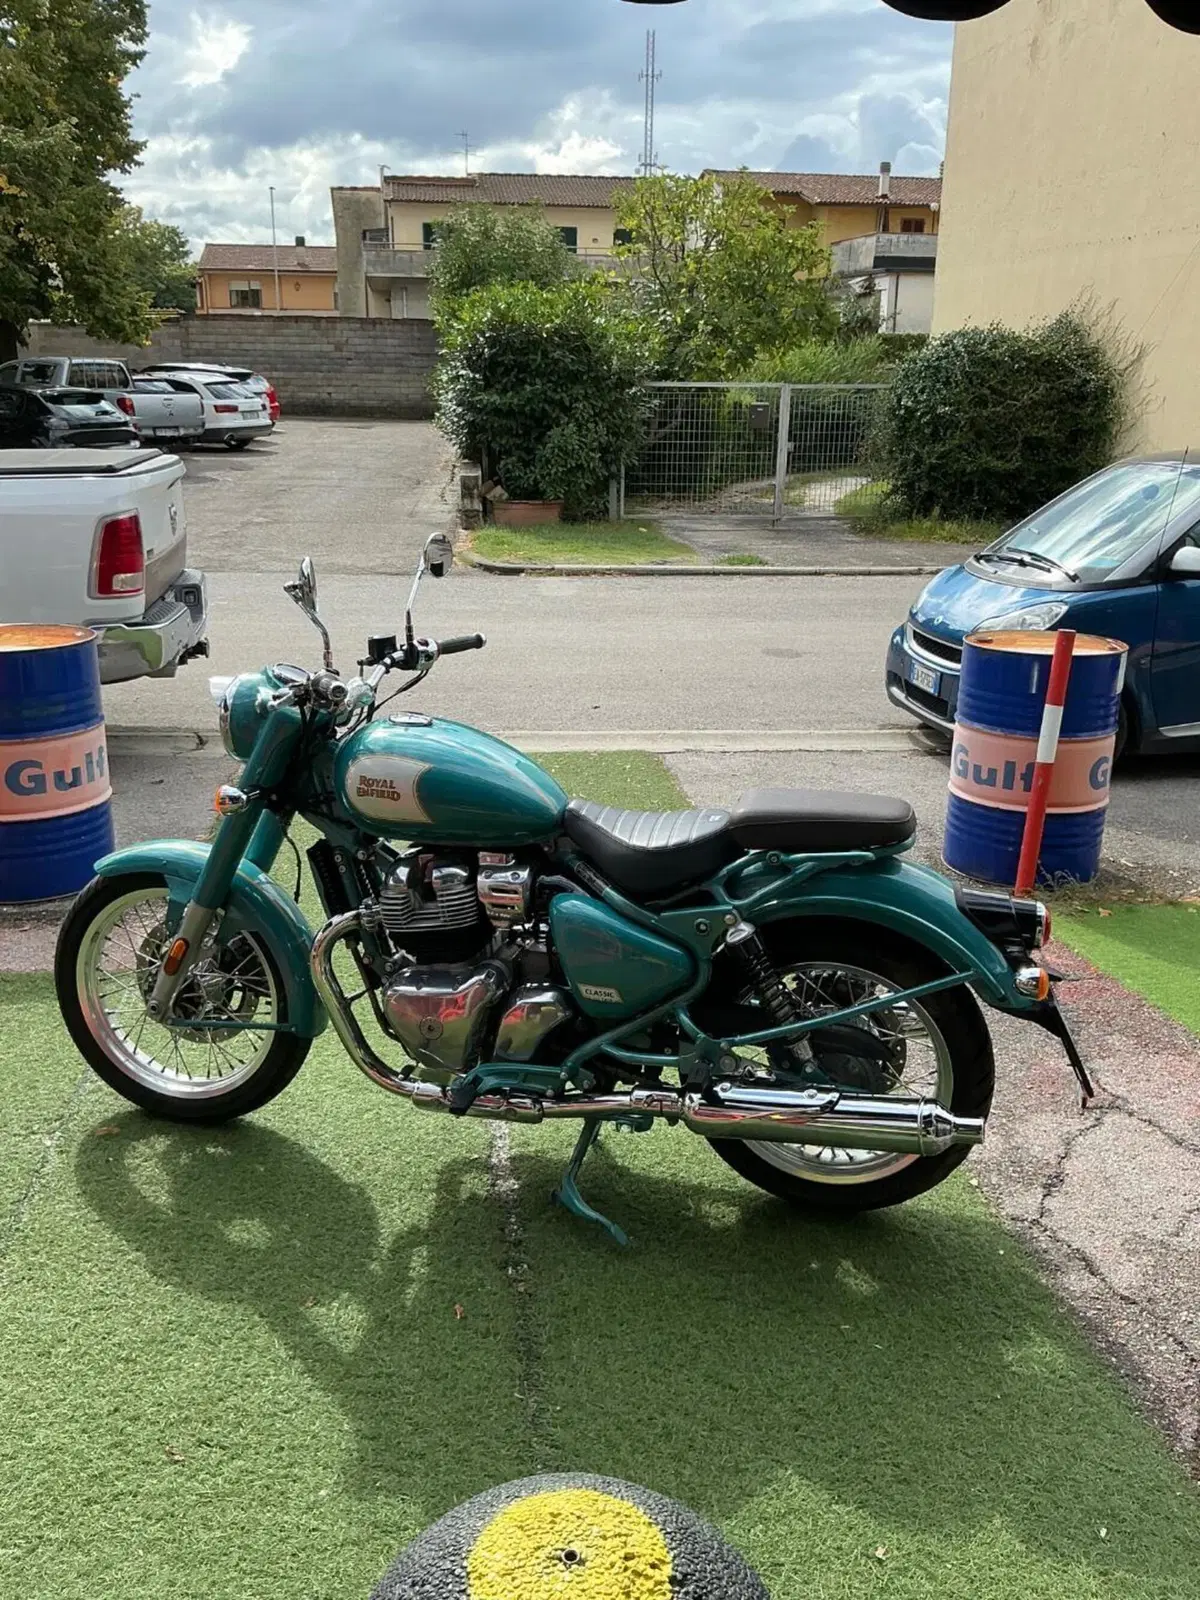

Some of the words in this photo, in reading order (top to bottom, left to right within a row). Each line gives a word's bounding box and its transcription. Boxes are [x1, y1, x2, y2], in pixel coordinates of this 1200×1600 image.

[4, 745, 104, 796] Gulf
[359, 775, 396, 789] ROYAL
[356, 786, 401, 801] ENFIELD
[585, 988, 614, 998] CLASSIC
